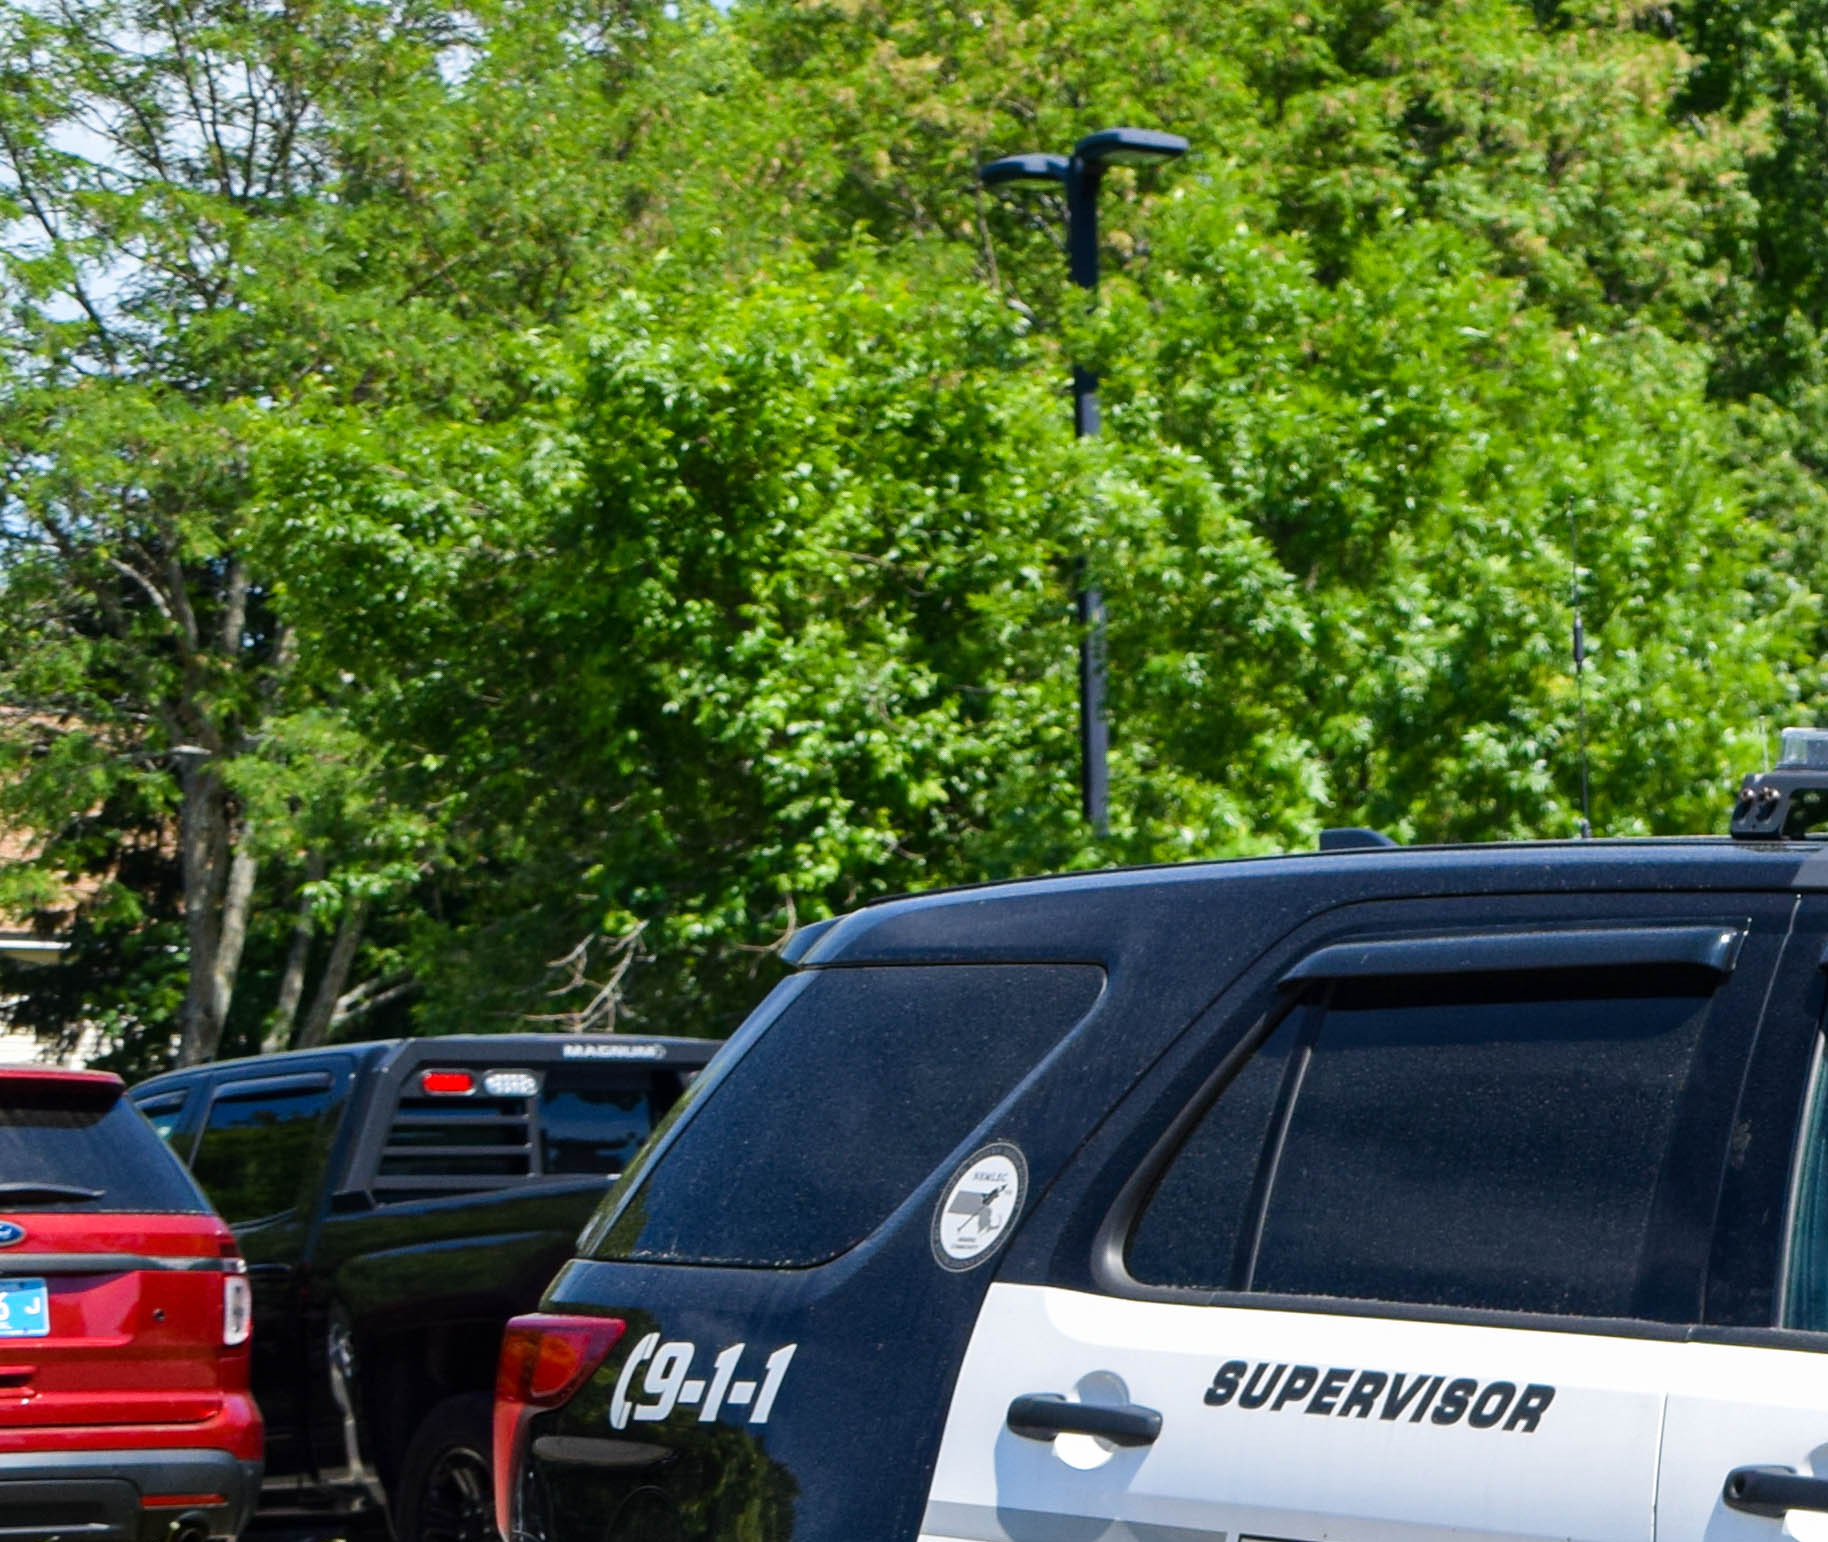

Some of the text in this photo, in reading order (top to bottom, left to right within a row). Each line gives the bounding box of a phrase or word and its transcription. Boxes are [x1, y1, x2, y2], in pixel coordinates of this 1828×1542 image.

[563, 1044, 656, 1059] MAGNUM
[633, 1341, 798, 1424] 9-1-1
[1203, 1360, 1556, 1433] SUPERVISOR
